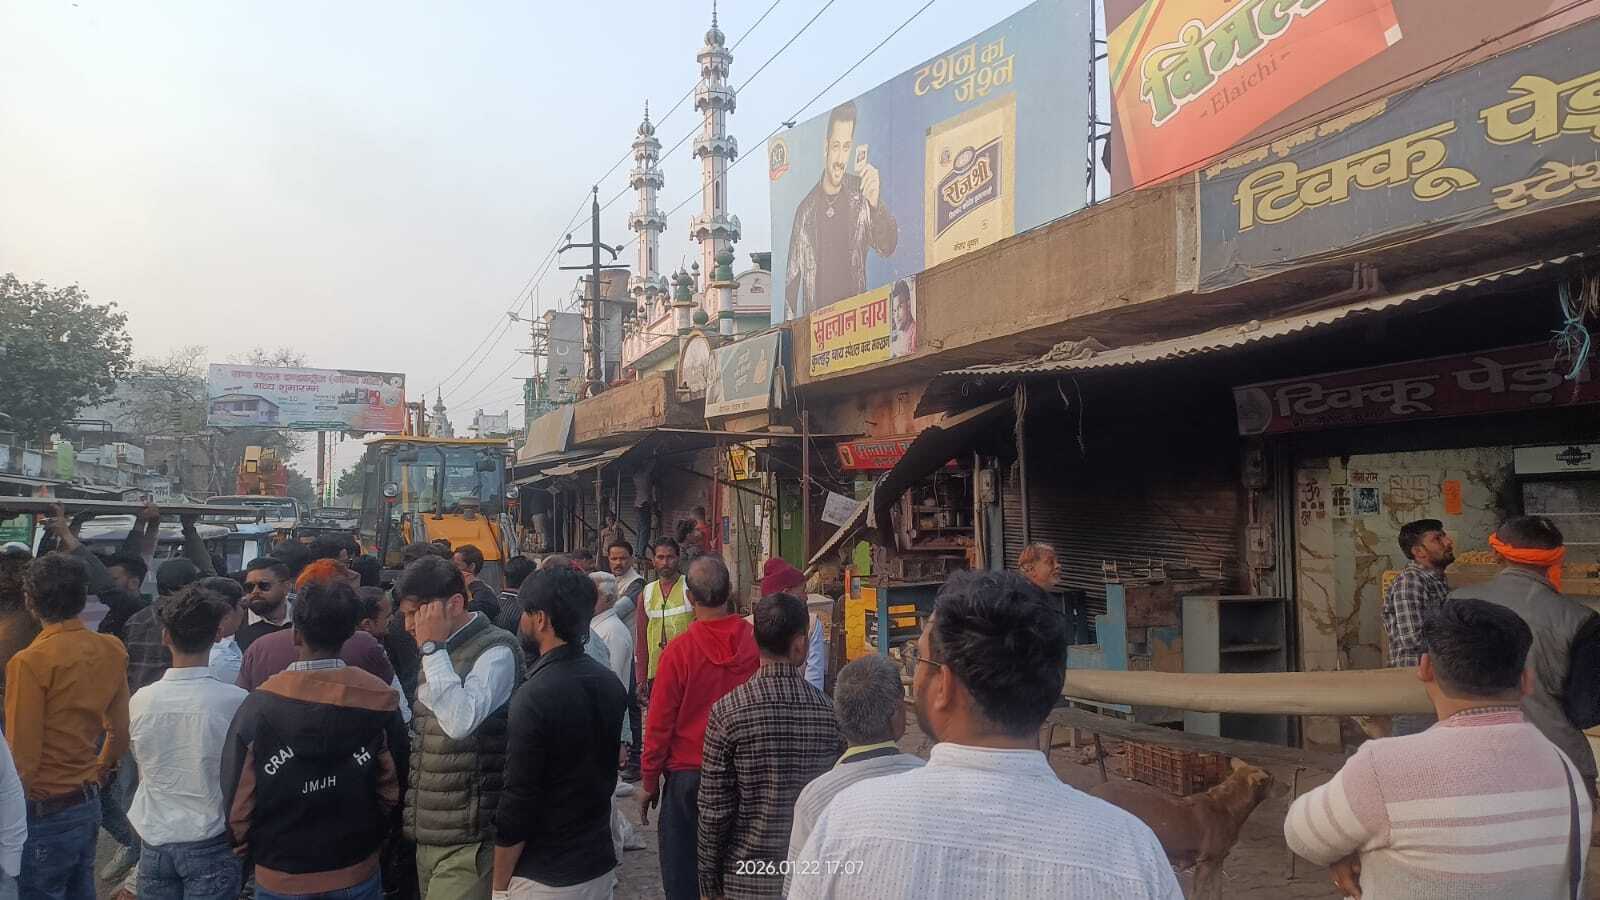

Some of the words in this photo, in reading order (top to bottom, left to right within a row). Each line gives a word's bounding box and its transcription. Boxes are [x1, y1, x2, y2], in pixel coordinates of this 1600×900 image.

[914, 40, 977, 96] टशन
[980, 35, 1006, 64] का
[954, 54, 1016, 102] जश्न
[1210, 55, 1278, 115] Elaichi
[943, 157, 992, 204] राजश्री
[1234, 121, 1479, 231] टिक्कू
[813, 308, 858, 351] सुल्तान
[860, 298, 888, 328] चाय
[1275, 374, 1441, 416] टिक्कू
[302, 775, 336, 794] JMJH
